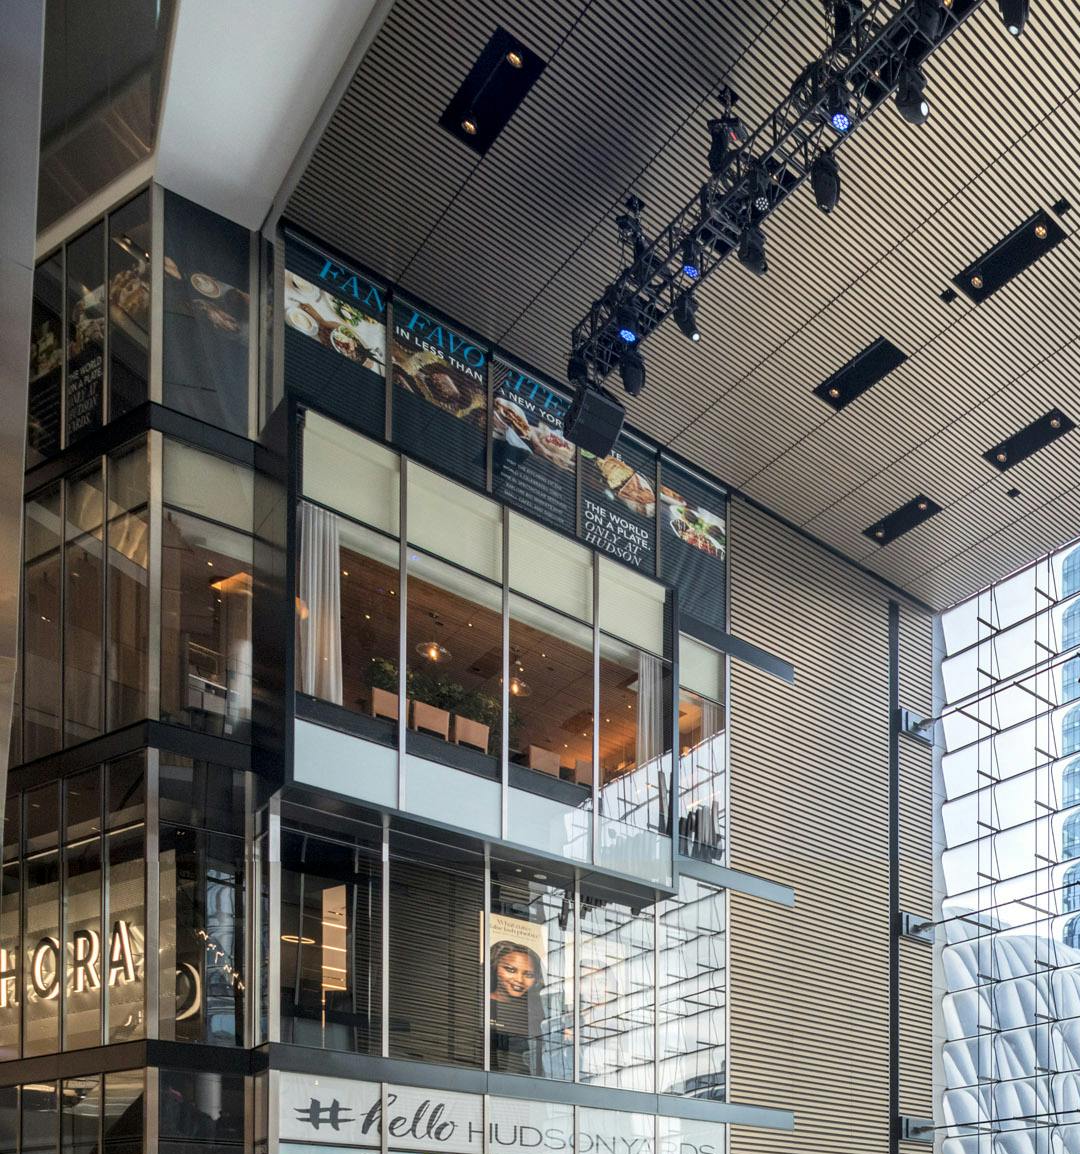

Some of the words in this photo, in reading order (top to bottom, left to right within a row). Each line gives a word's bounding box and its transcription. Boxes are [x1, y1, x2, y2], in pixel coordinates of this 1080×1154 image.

[395, 326, 410, 341] IN
[415, 337, 444, 360] LESS
[448, 356, 484, 384] THAN
[508, 391, 536, 412] NEW
[540, 408, 565, 429] YOR
[584, 499, 607, 518] THE
[609, 513, 649, 539] WORLD
[584, 510, 603, 524] ON
[606, 521, 615, 532] A
[617, 526, 651, 551] PLATE.
[585, 521, 622, 544] ONLY
[625, 541, 642, 555] AT
[585, 532, 642, 567] HUDSON
